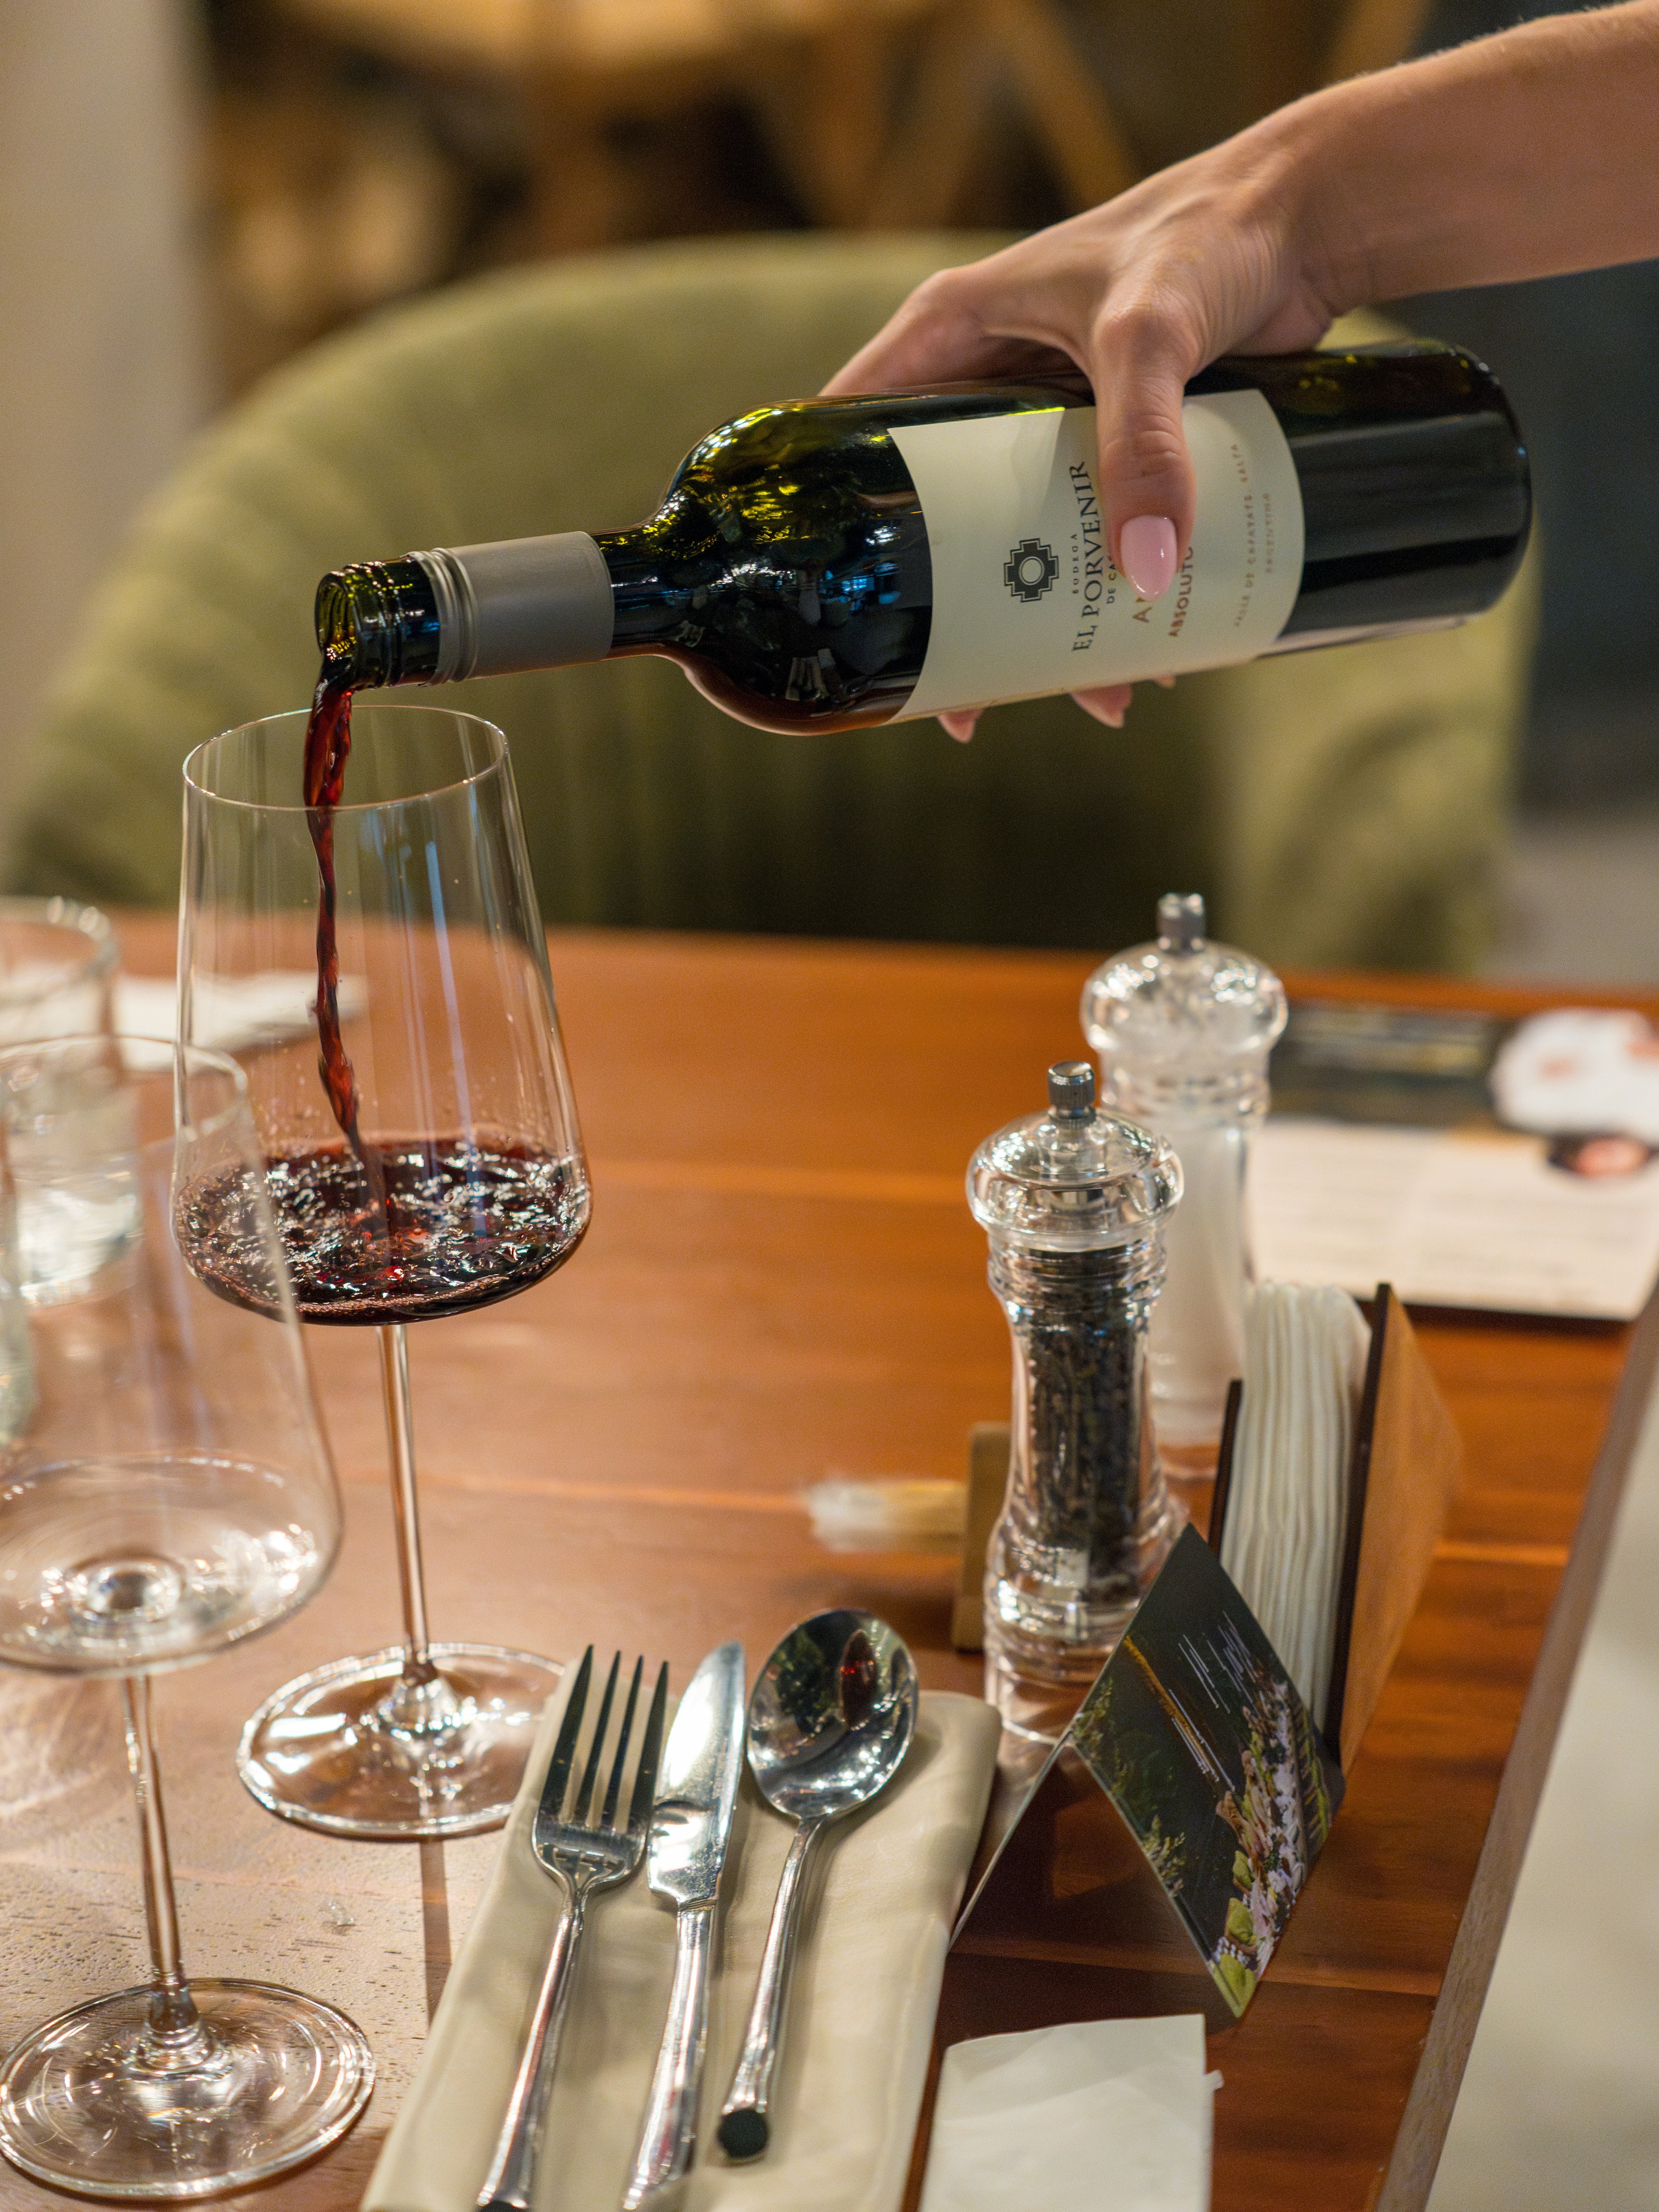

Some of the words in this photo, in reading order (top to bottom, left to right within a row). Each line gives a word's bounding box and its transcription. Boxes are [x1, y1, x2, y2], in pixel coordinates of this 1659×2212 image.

[1069, 461, 1104, 618] PORVENIR
[1070, 533, 1080, 594] BODEGA
[1106, 588, 1116, 604] DE
[1071, 625, 1098, 651] EL
